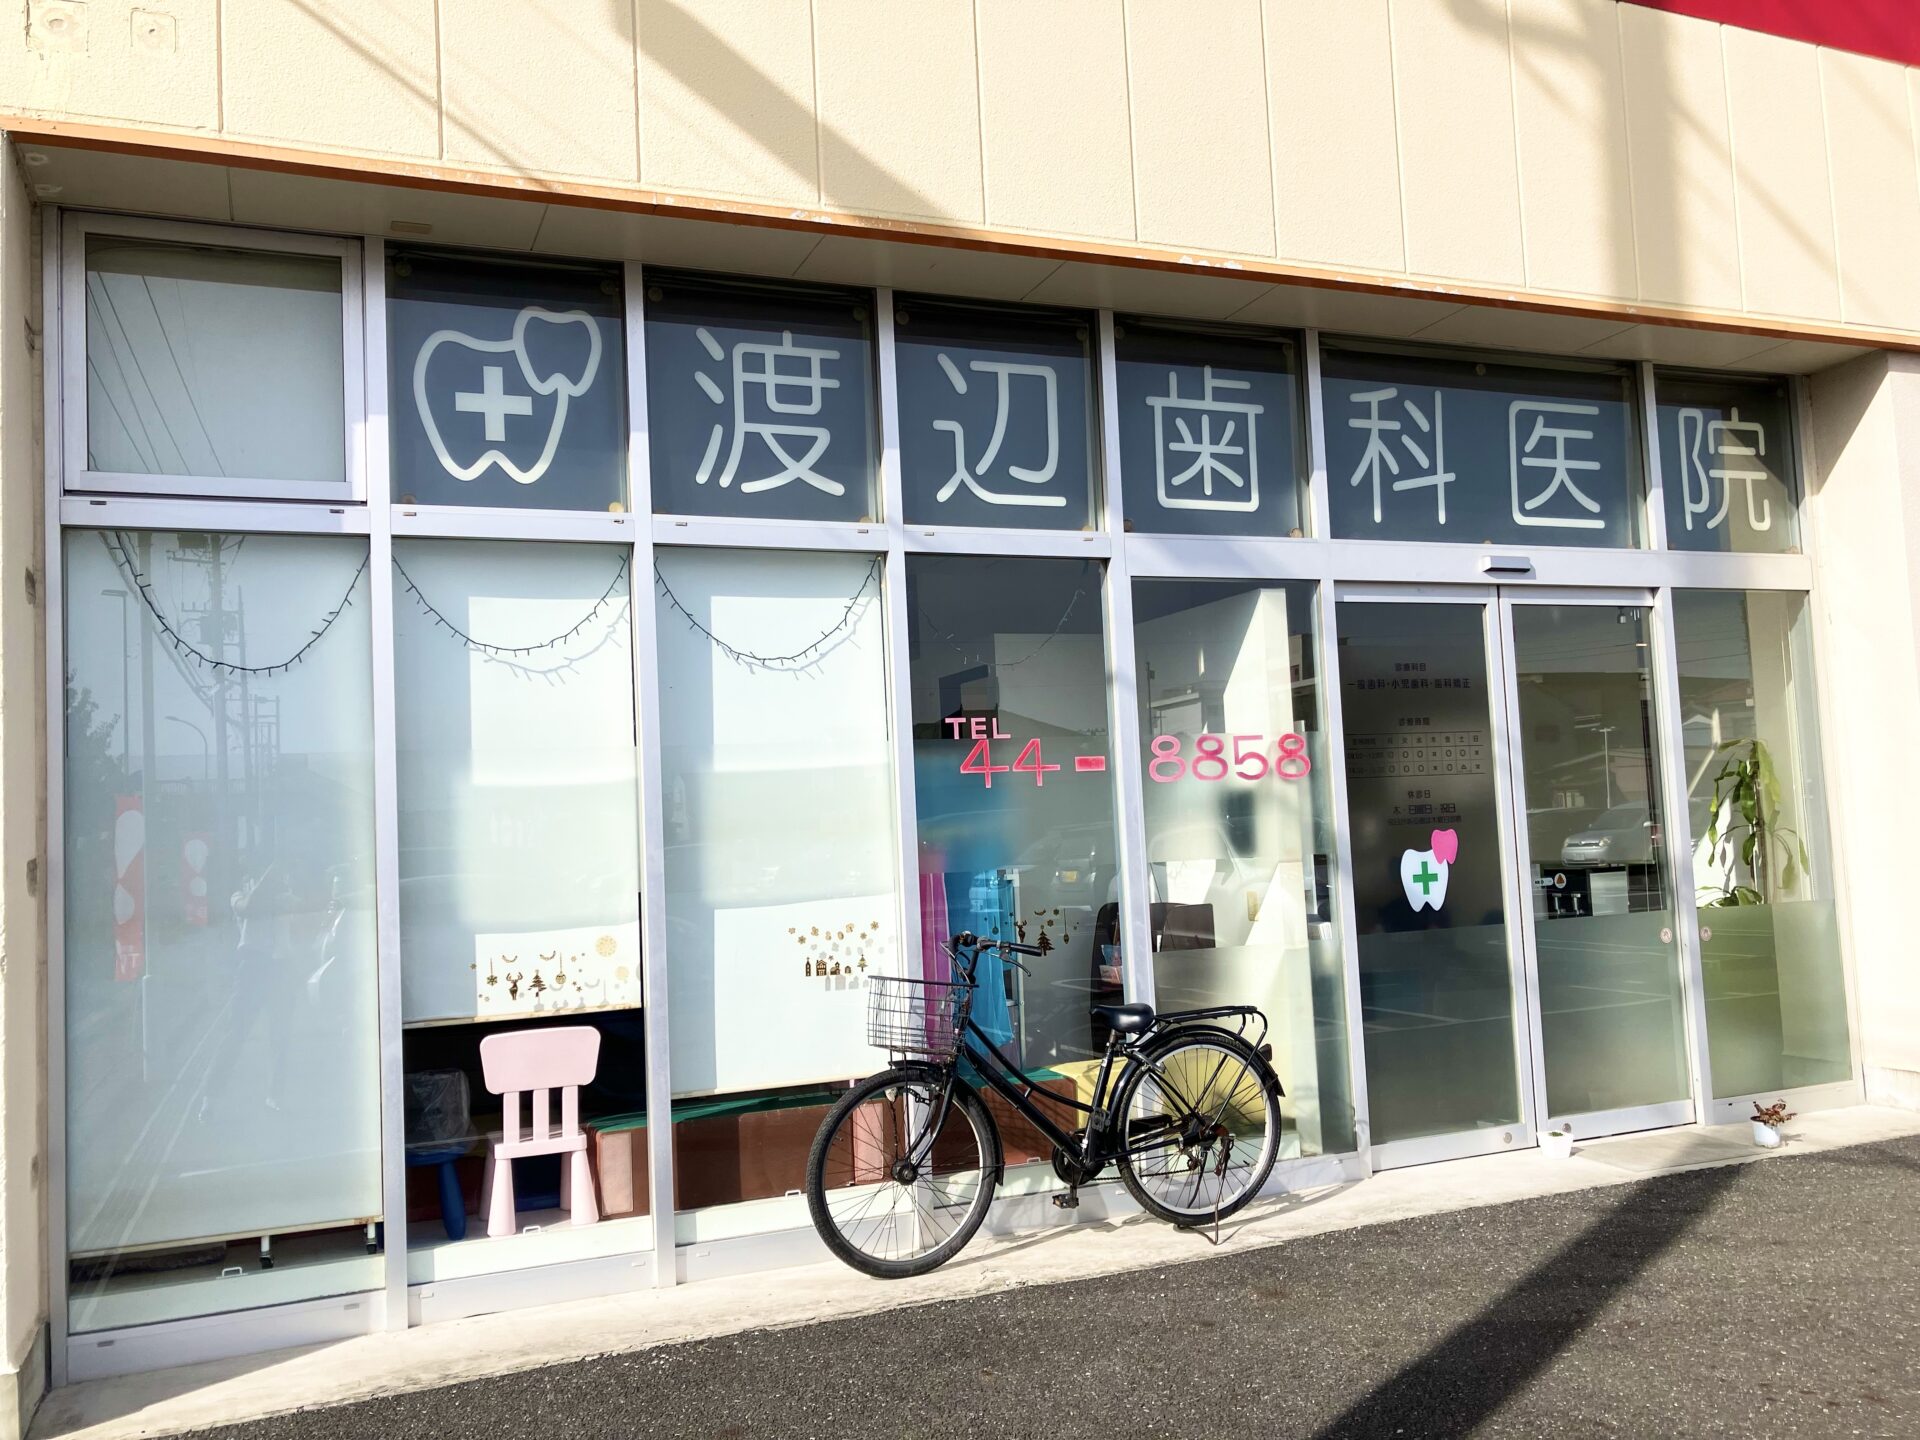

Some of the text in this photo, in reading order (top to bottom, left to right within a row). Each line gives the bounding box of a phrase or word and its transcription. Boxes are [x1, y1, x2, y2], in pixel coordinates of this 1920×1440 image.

[694, 329, 1772, 531] 渡辺歯科医院
[945, 717, 1011, 740] TEL
